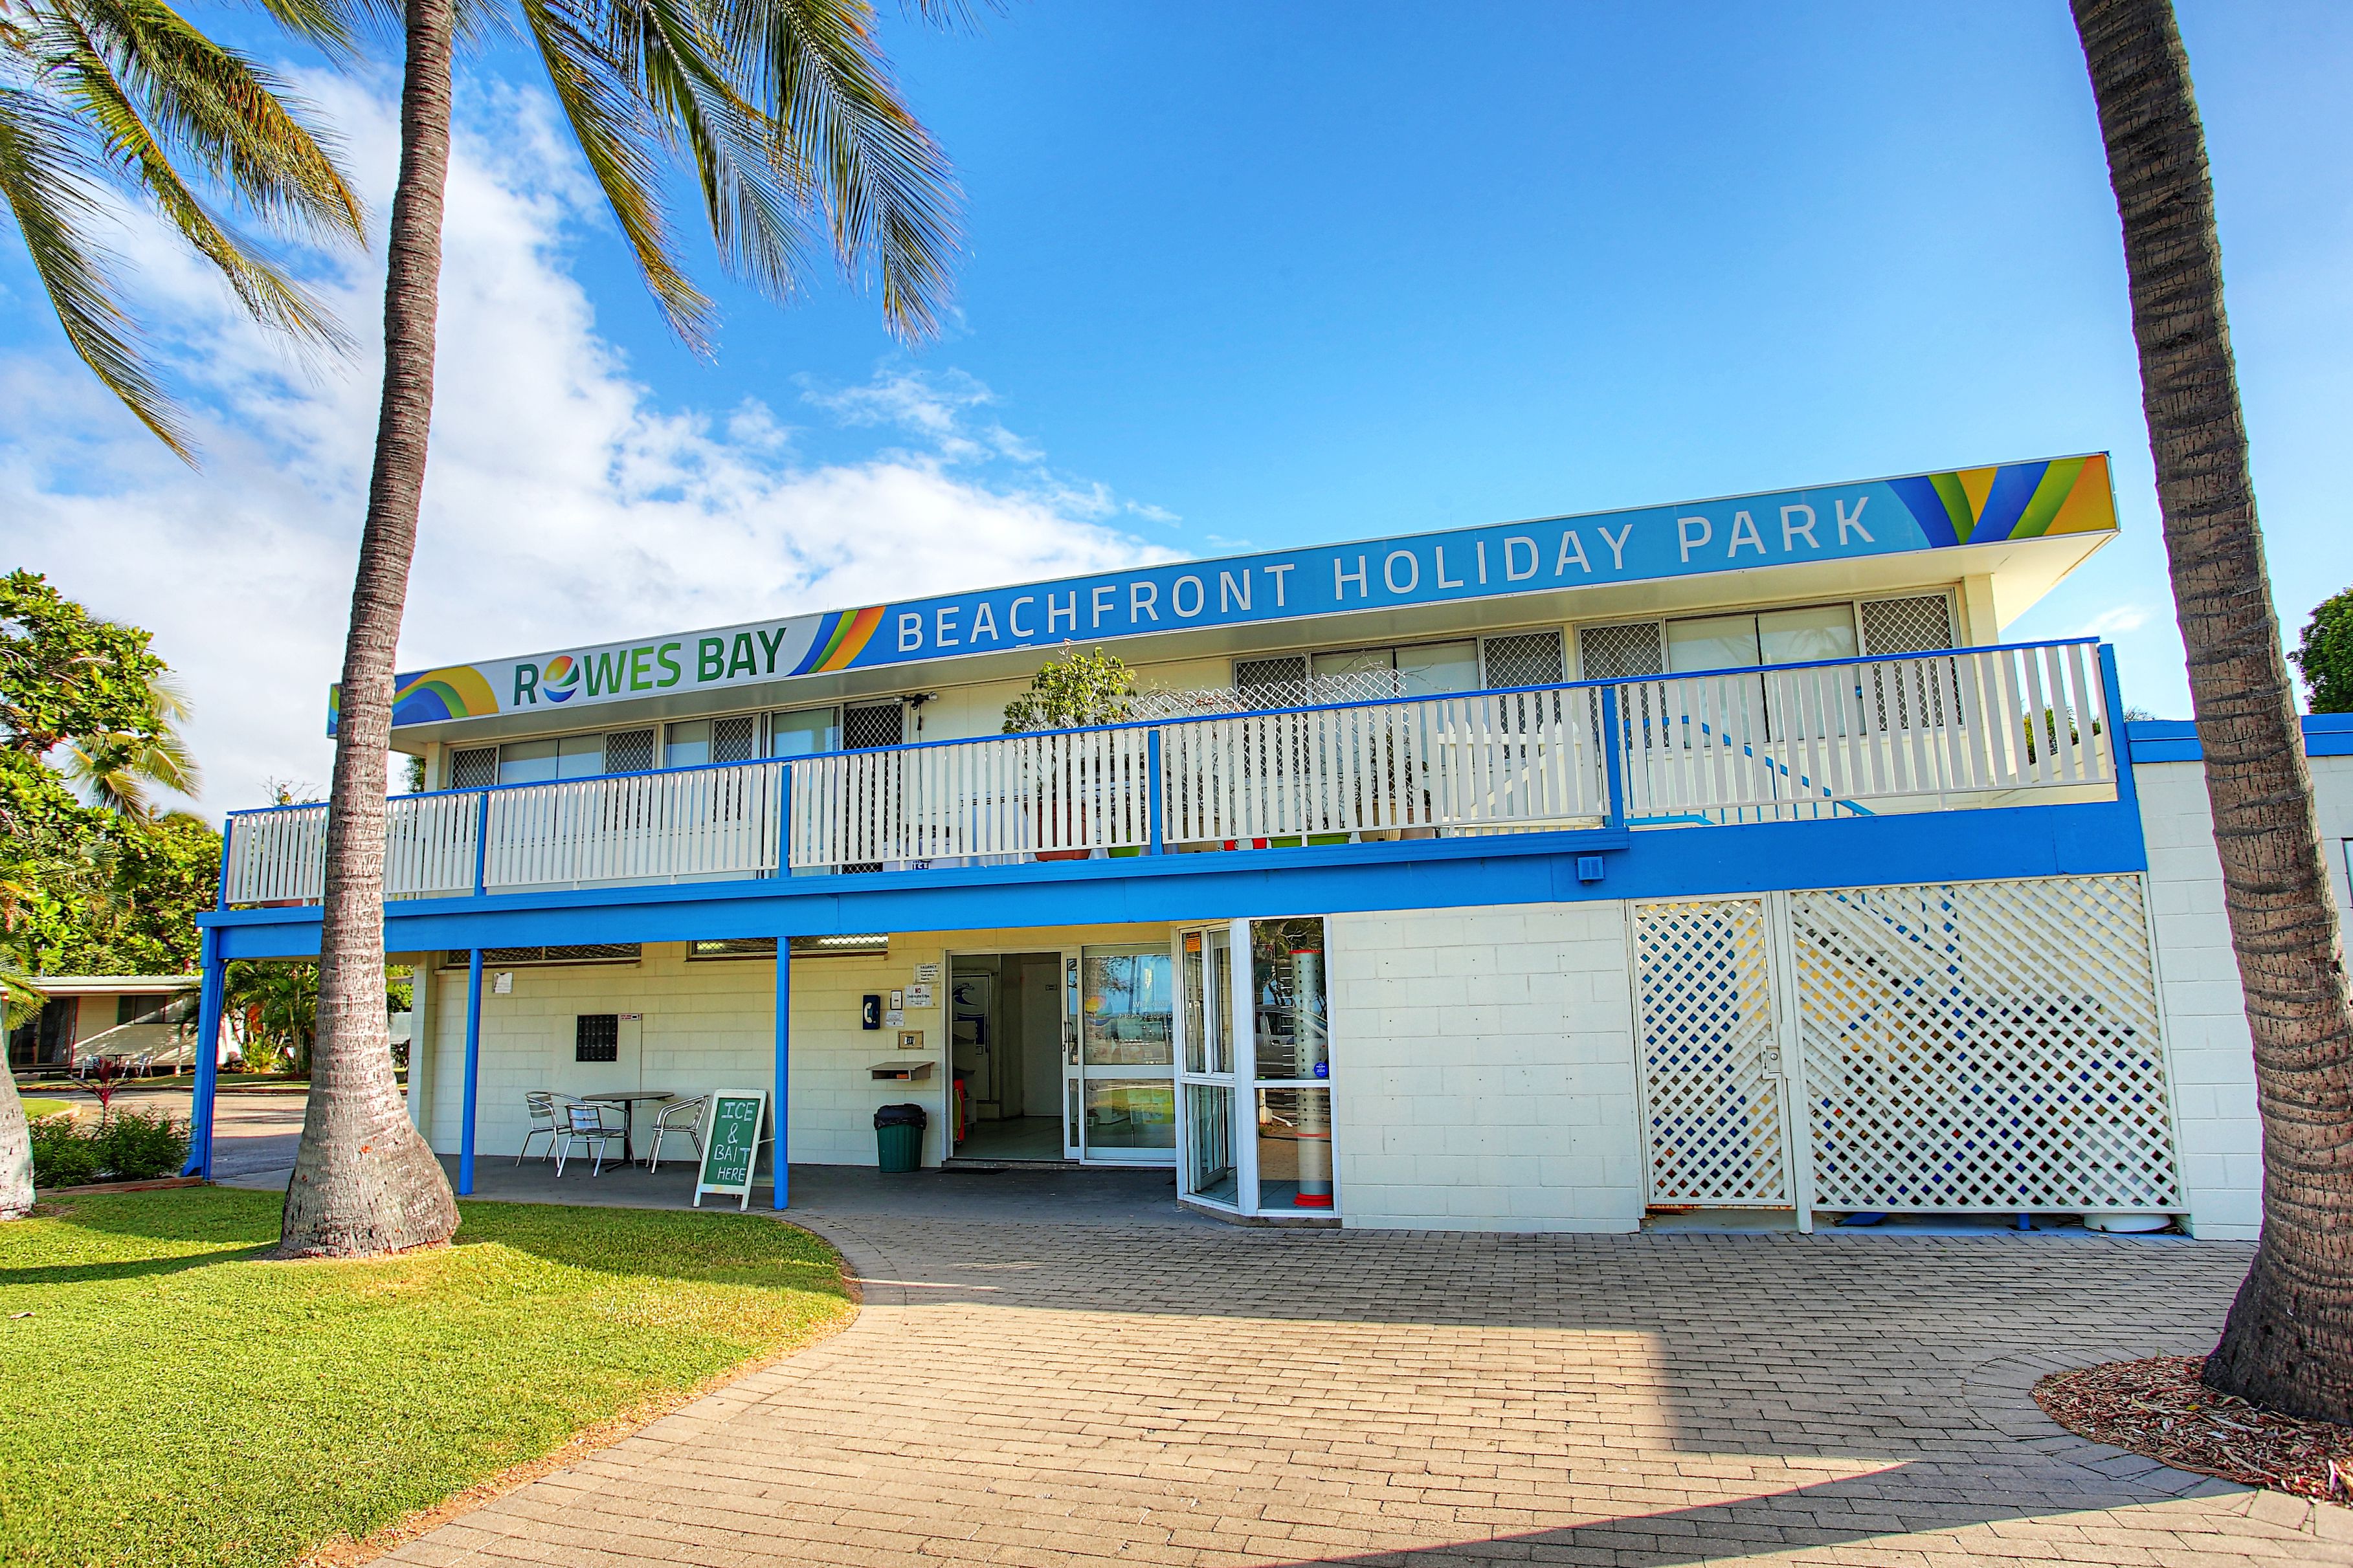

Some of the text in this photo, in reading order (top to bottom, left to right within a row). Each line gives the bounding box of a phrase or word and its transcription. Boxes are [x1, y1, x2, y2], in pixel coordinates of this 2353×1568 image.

[513, 496, 1875, 706] ROWES BAY BEACHFRONT HOLIDAY PARK
[721, 1102, 755, 1121] ICE
[728, 1122, 738, 1144] &
[713, 1143, 751, 1164] BAIT
[717, 1166, 746, 1182] HERE
